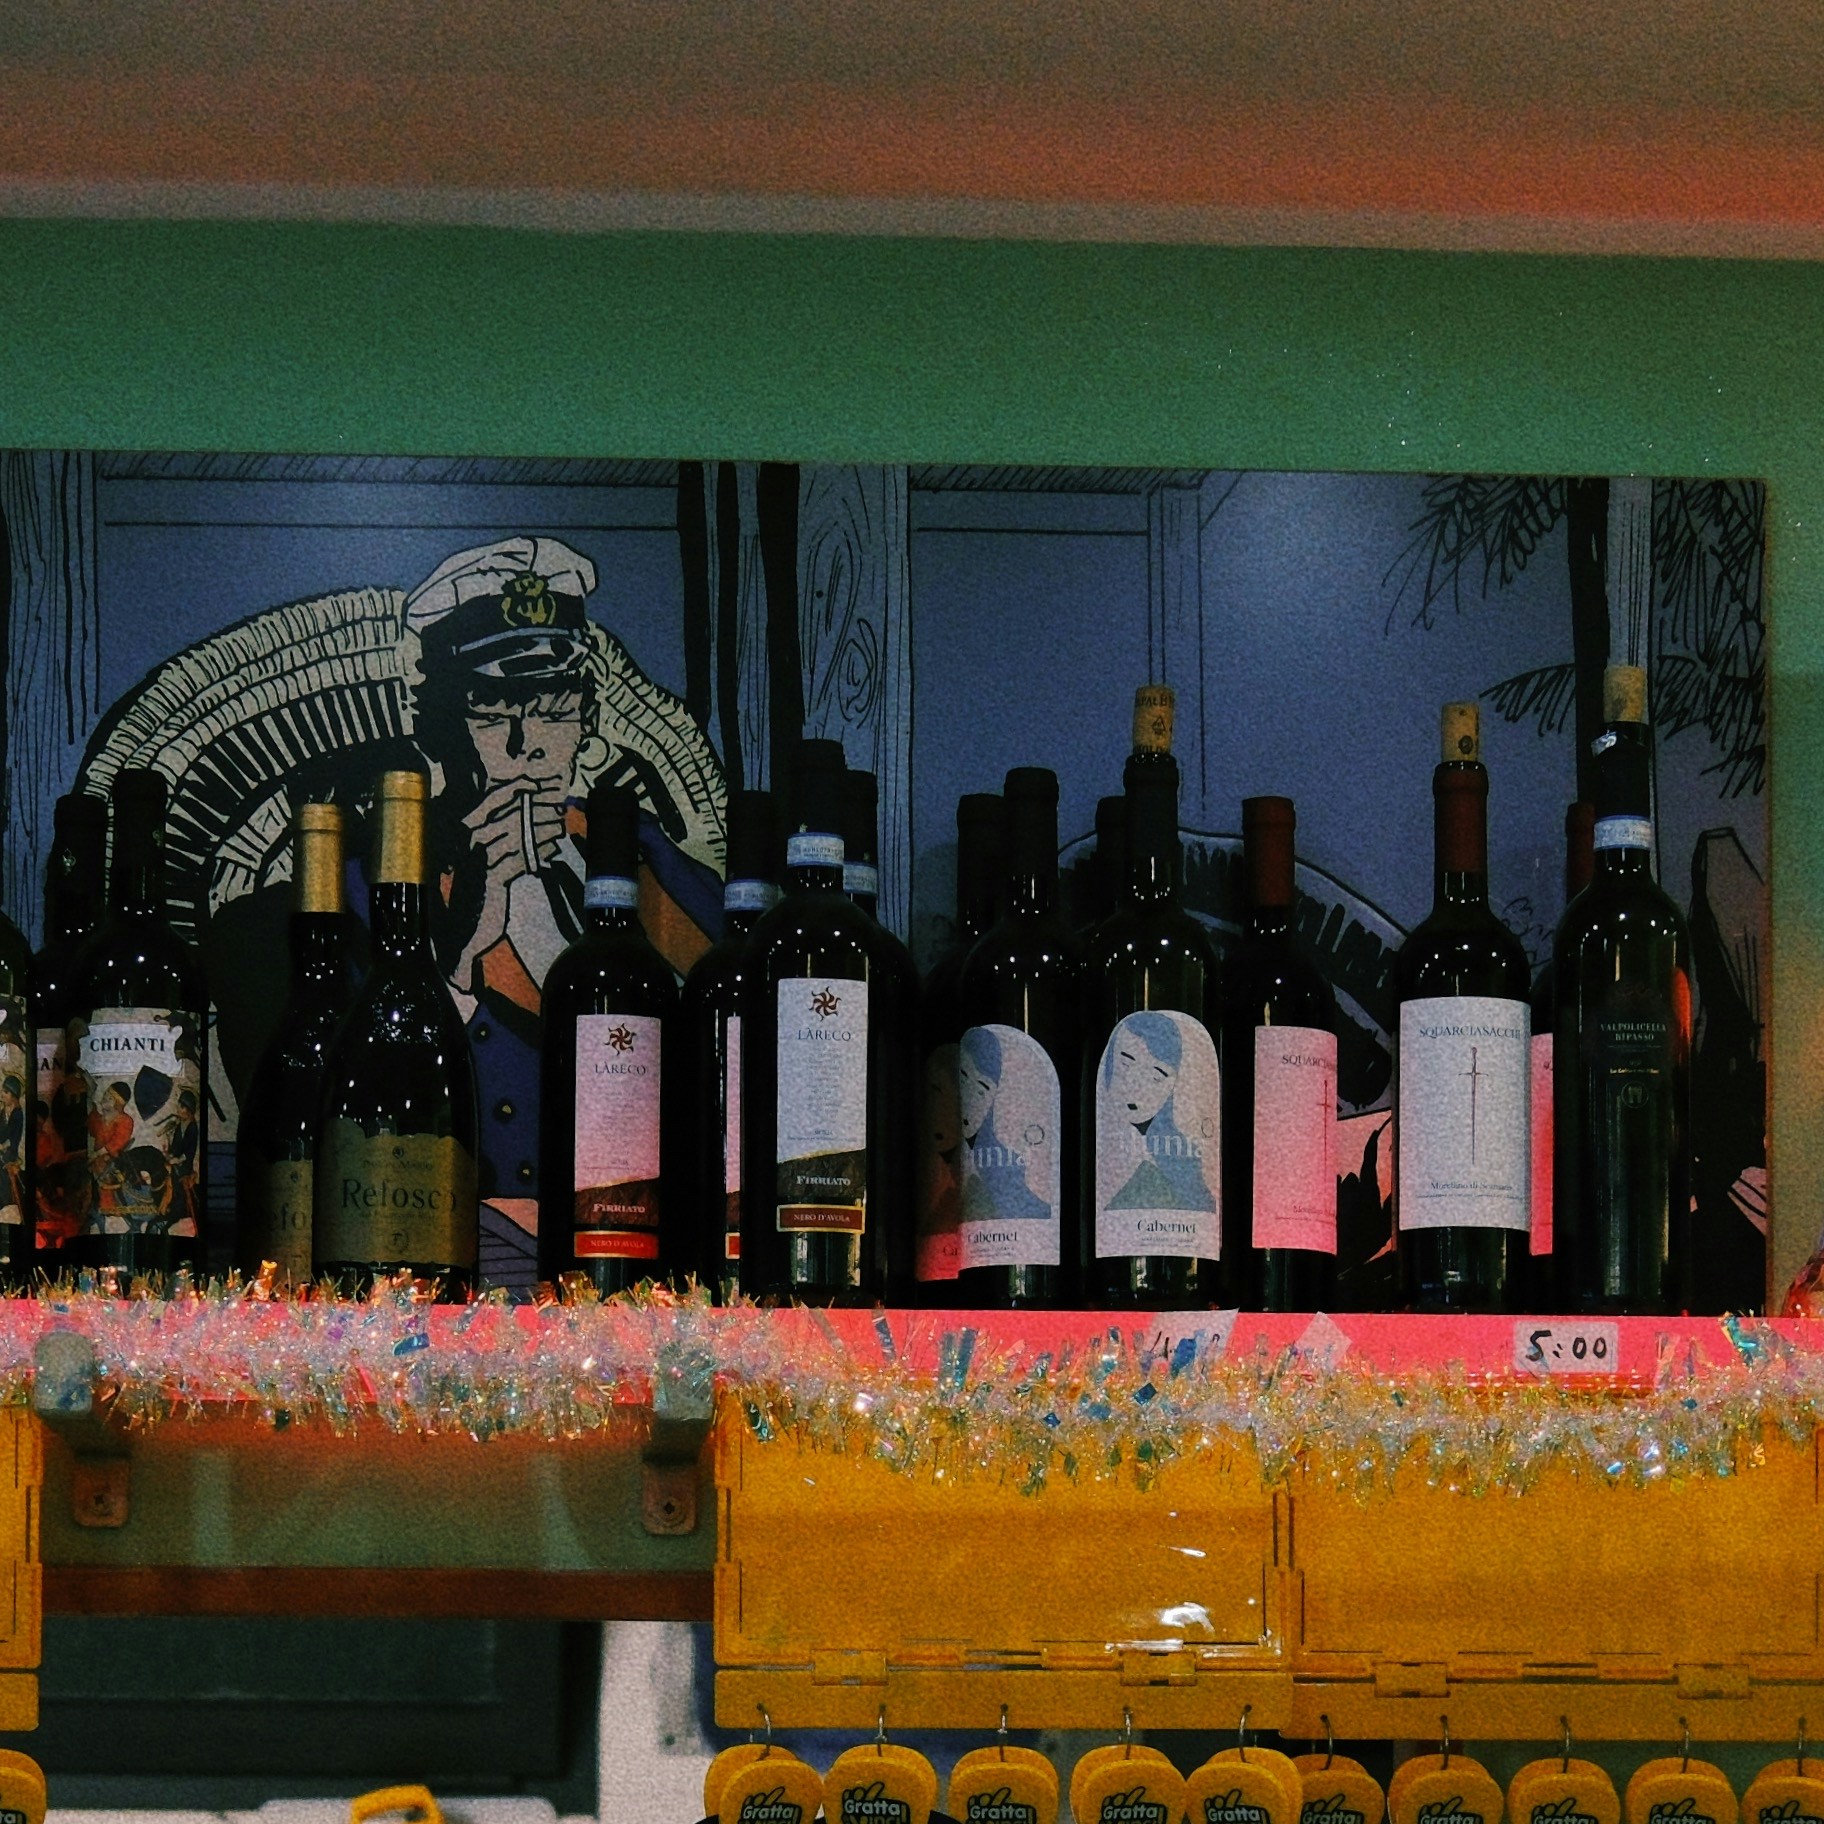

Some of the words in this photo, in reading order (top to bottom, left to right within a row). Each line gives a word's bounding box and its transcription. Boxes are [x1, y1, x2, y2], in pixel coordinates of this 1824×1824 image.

[89, 1034, 167, 1055] CHIANTI
[796, 1174, 852, 1188] FIRRIATO
[592, 1201, 646, 1216] FIRRIATO
[793, 1212, 816, 1223] NERO
[1137, 1218, 1197, 1234] Cabernet
